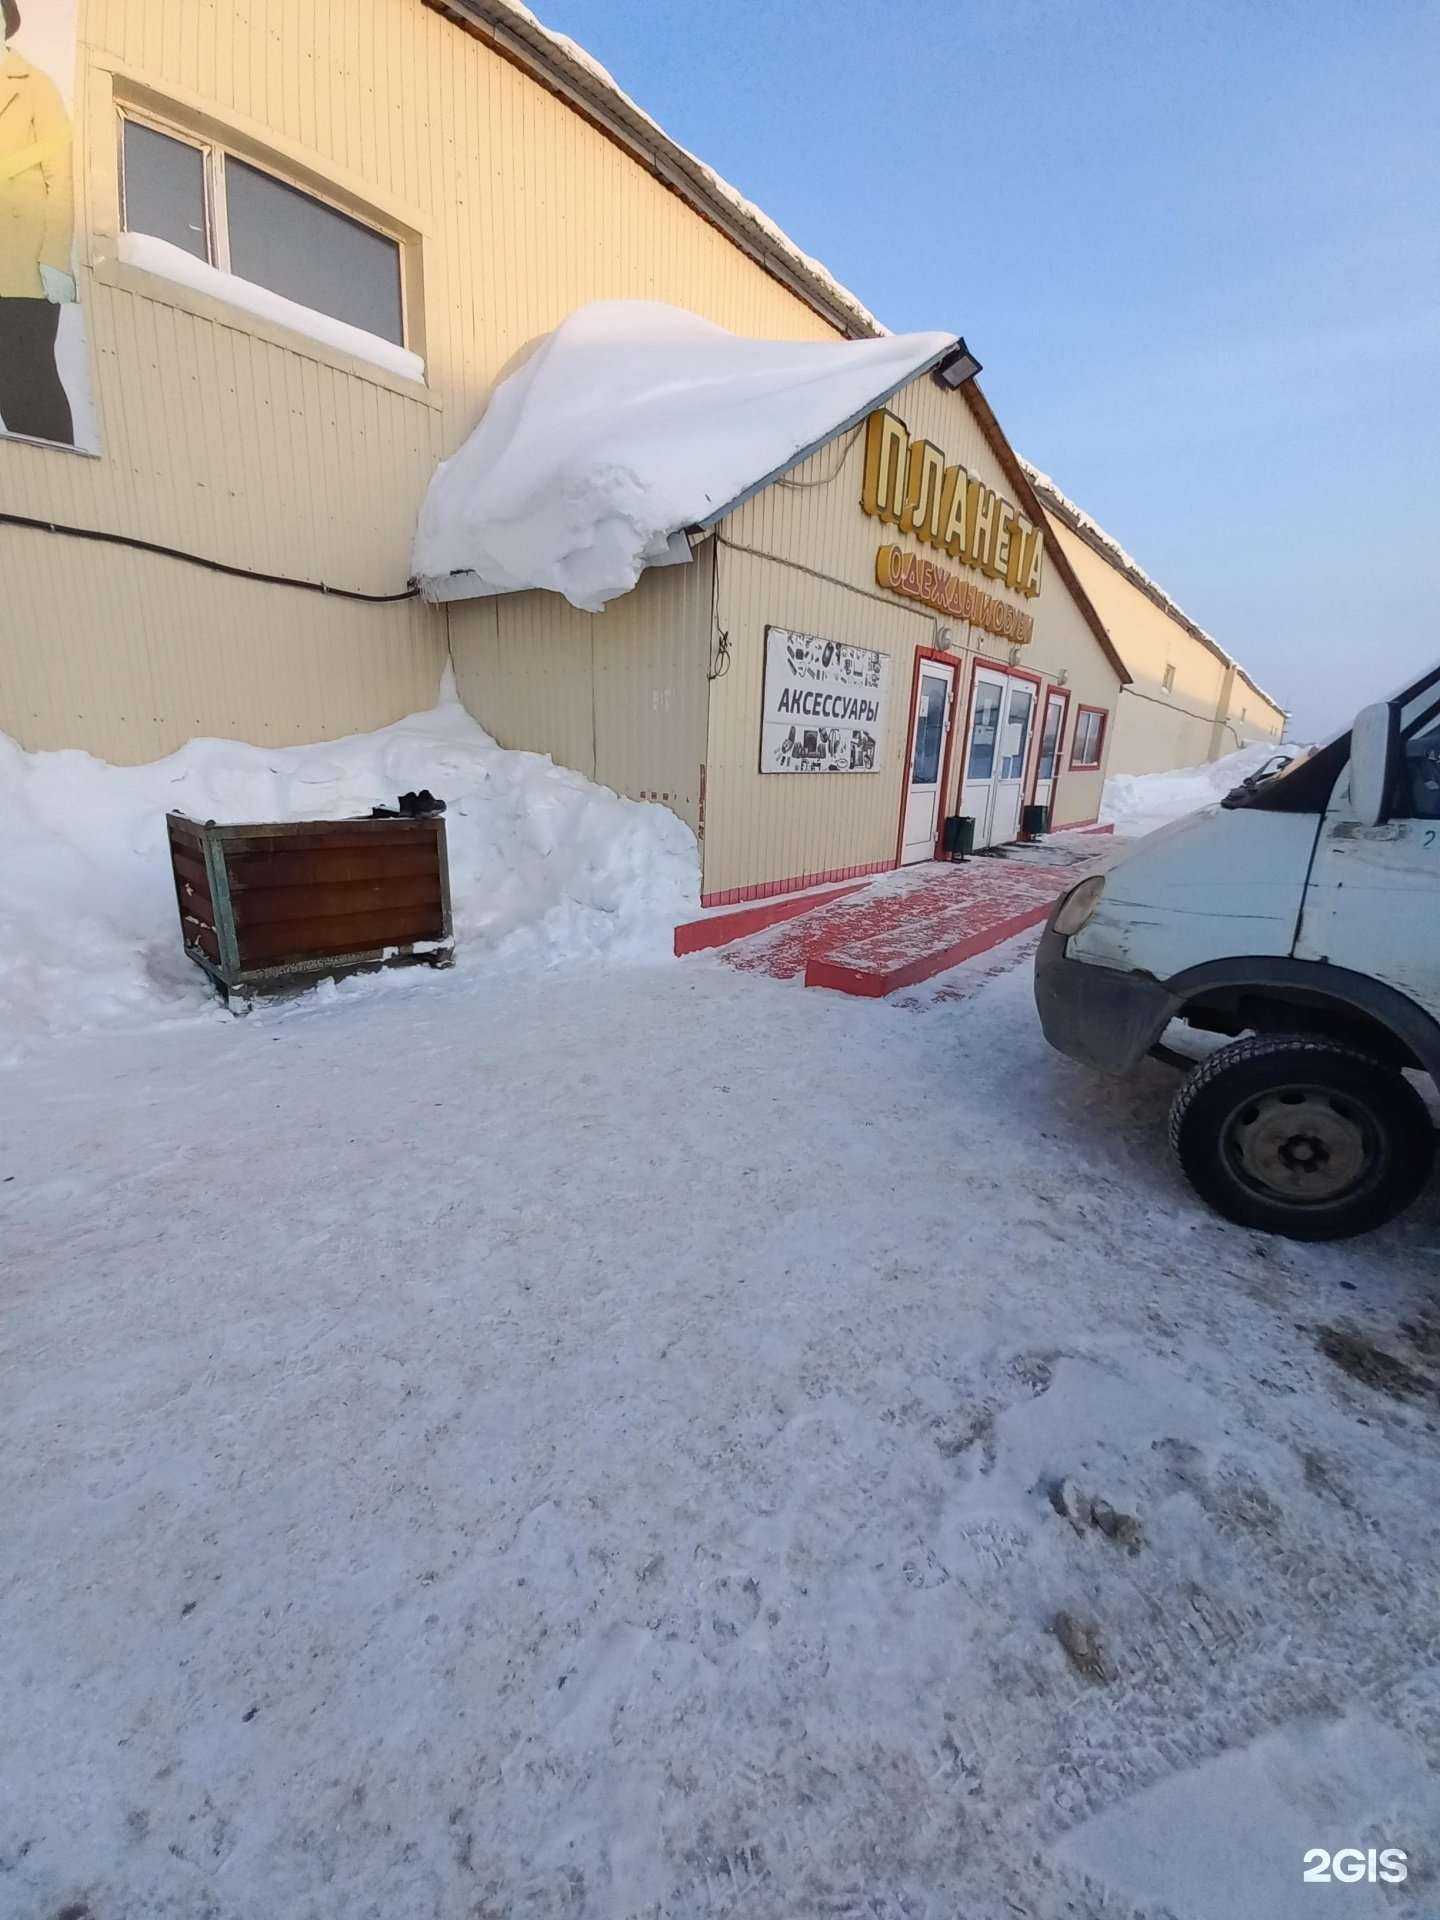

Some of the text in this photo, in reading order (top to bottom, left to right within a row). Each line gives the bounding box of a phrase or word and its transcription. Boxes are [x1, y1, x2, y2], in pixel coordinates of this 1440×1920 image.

[864, 408, 1043, 598] ПЛАНЕТА
[878, 545, 976, 618] ОДЕЖДЫ
[777, 687, 880, 722] АКСЕССУАРЫ
